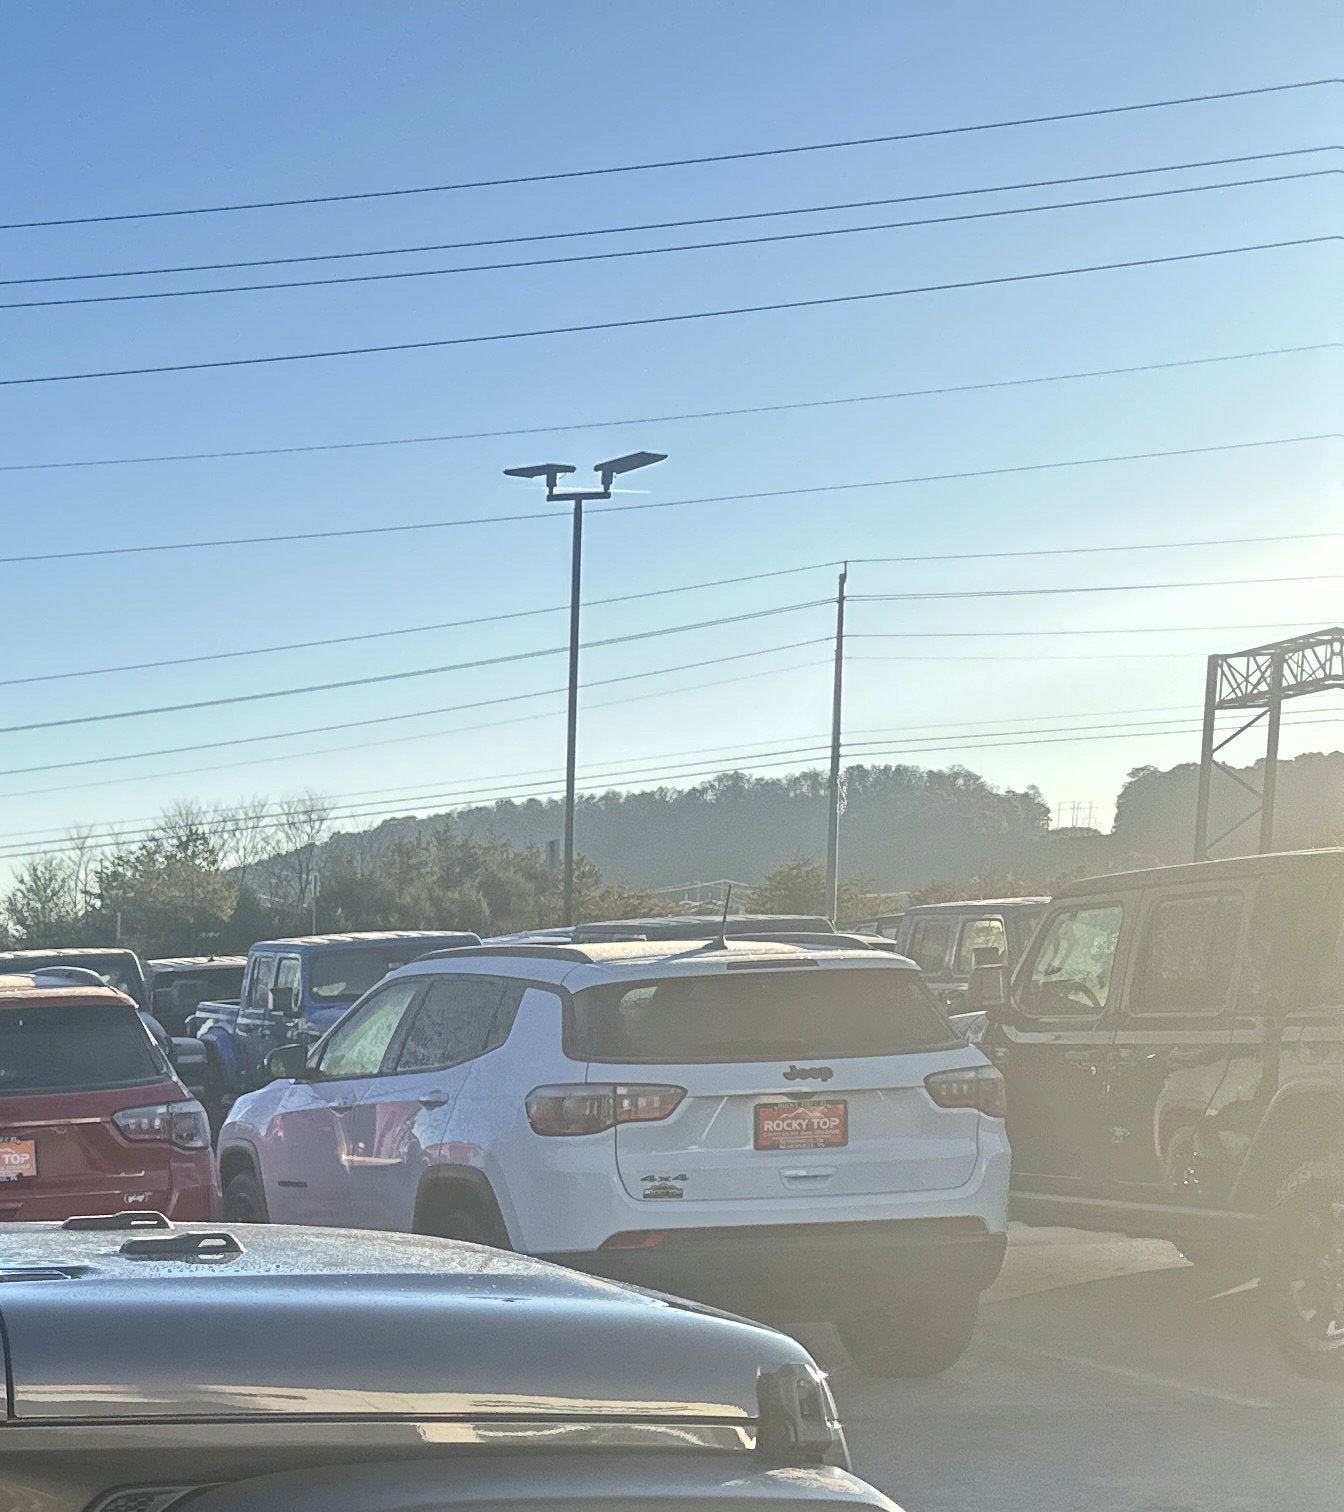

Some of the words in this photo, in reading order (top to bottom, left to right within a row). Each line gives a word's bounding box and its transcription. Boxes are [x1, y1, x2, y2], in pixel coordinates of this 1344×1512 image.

[782, 1064, 833, 1082] Jeep
[763, 1119, 808, 1131] ROCKY
[811, 1117, 839, 1129] TOP
[2, 1153, 30, 1164] TOP
